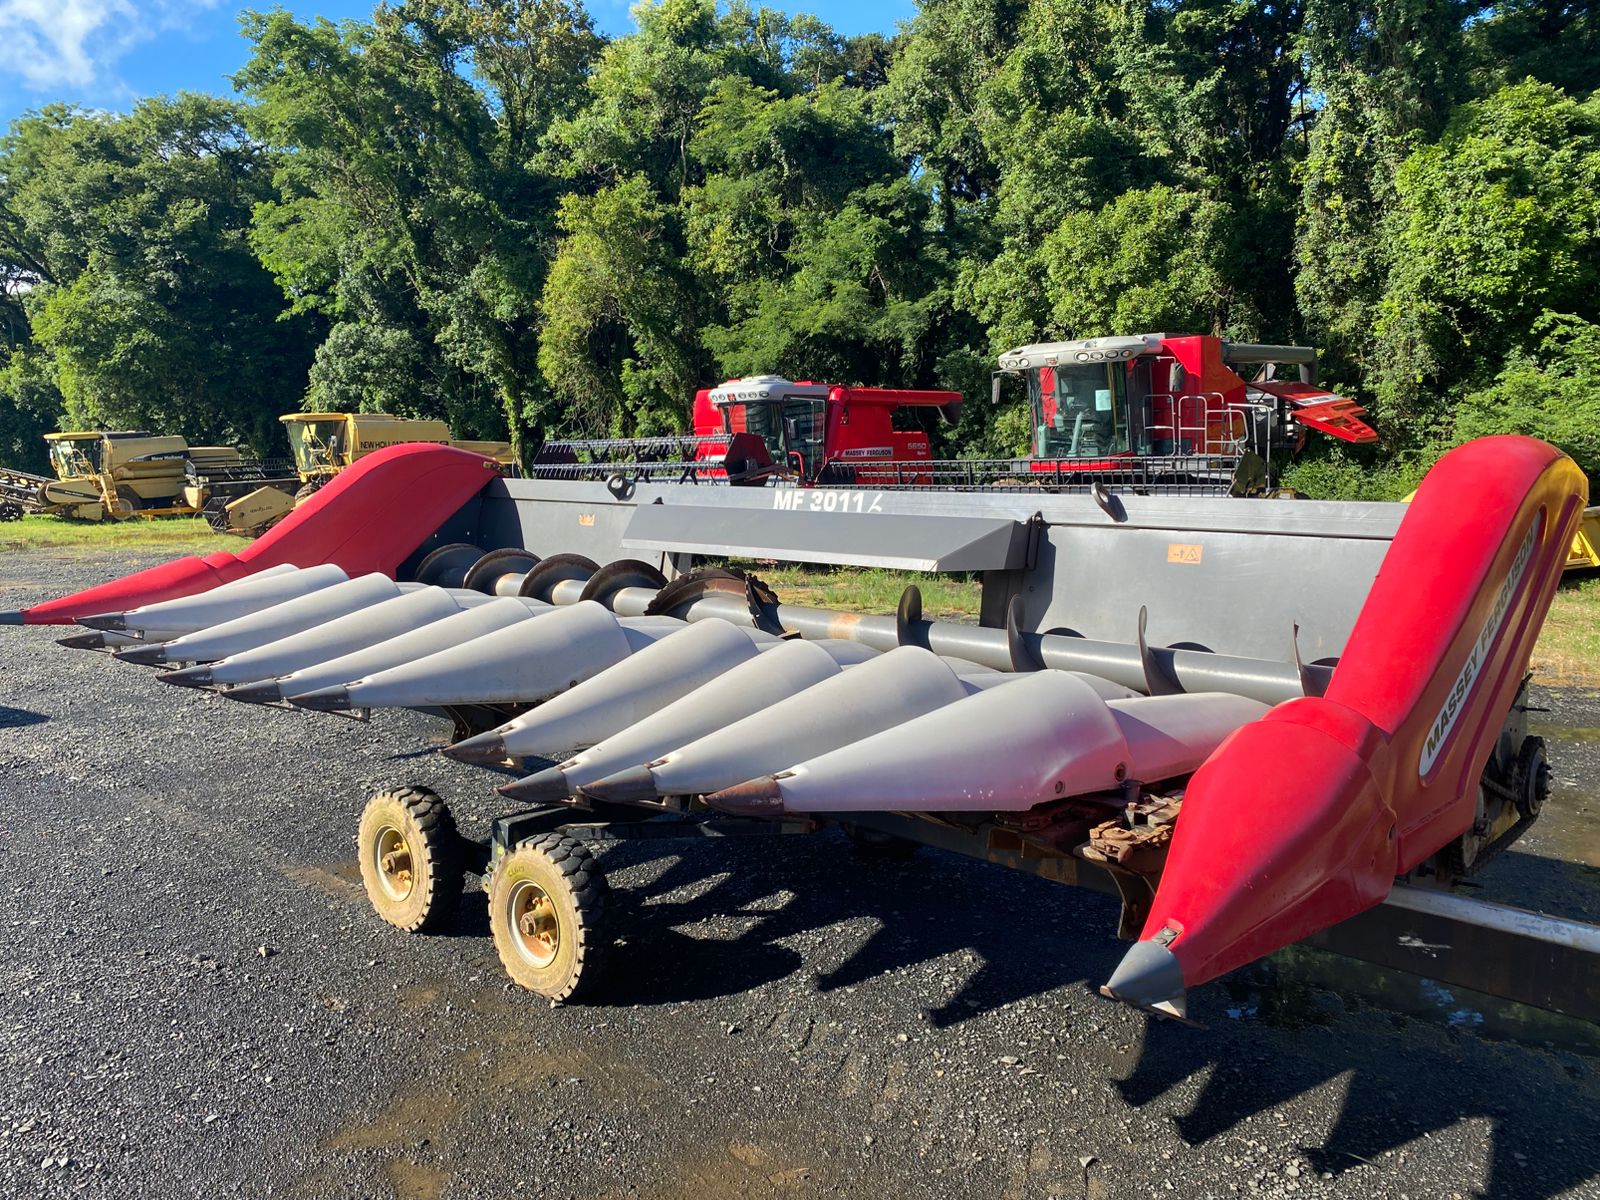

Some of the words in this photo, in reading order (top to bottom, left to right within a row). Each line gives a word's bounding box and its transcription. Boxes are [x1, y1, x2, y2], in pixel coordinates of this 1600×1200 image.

[376, 440, 404, 449] HOLLAN
[773, 490, 804, 510] MF
[1427, 647, 1478, 758] MASSEY
[1480, 528, 1533, 653] FERGUSON
